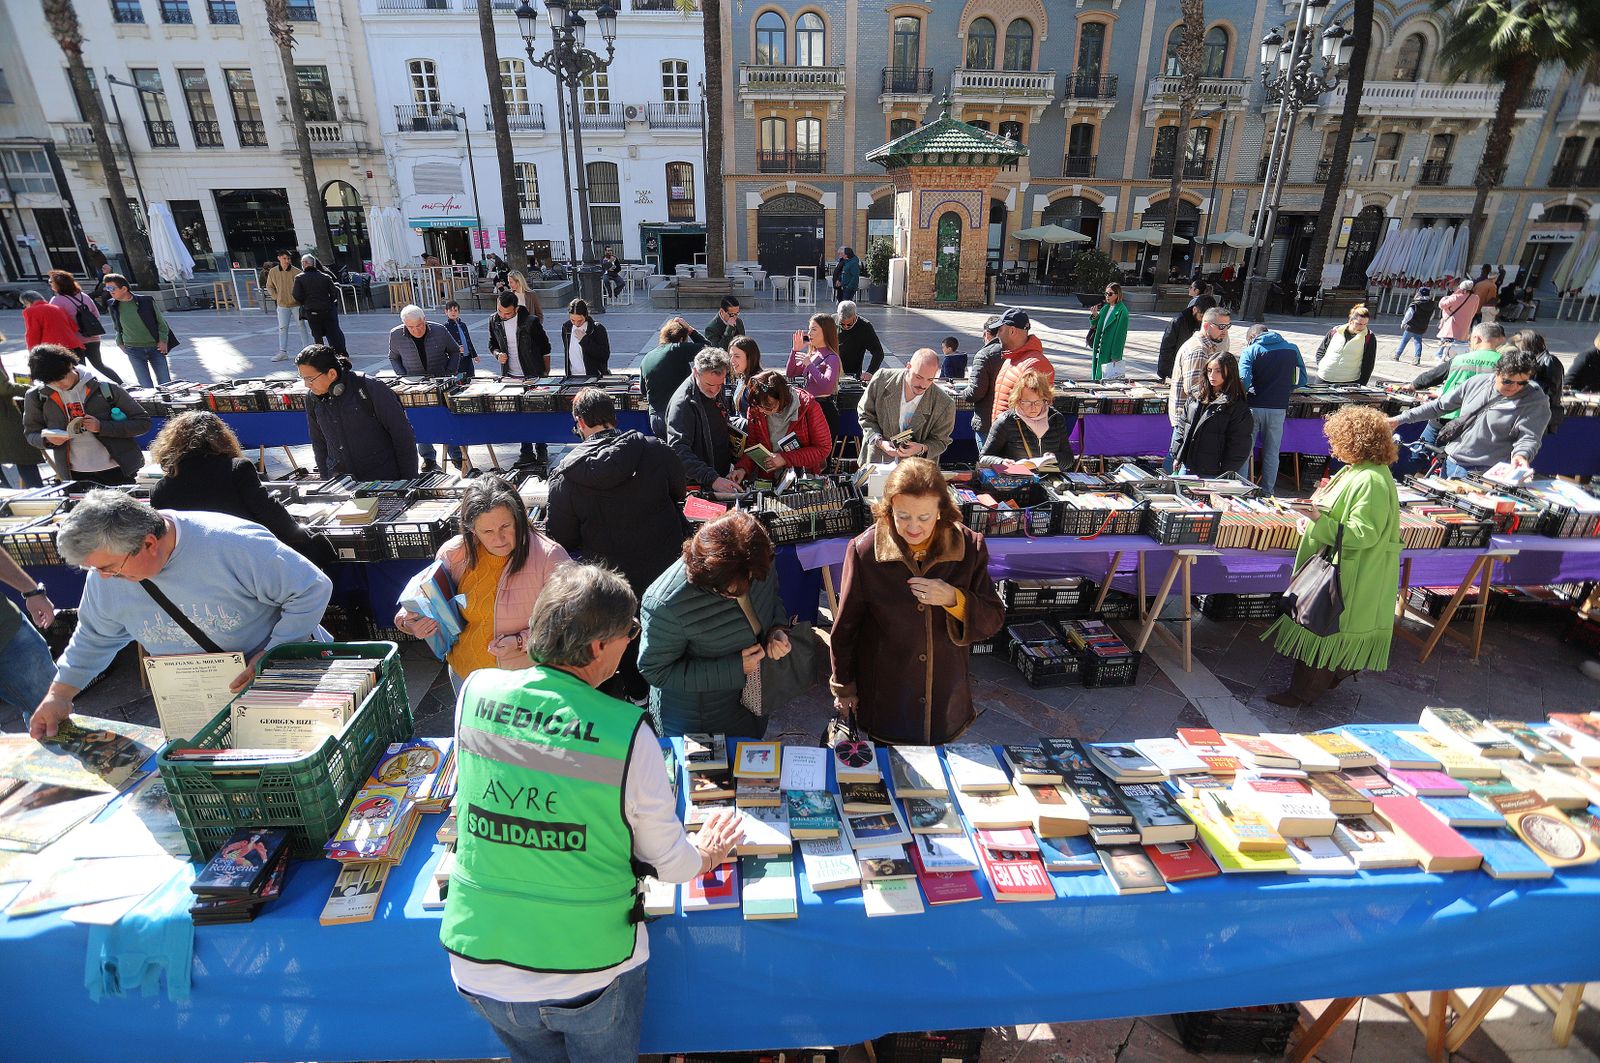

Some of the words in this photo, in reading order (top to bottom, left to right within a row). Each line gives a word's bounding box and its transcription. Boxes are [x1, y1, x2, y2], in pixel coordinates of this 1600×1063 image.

[475, 697, 600, 743] MEDICAL
[482, 779, 558, 814] AYRE
[1124, 789, 1154, 797] PRECIO
[468, 812, 585, 850] SOLIDARIO
[990, 865, 1014, 887] REY
[1007, 865, 1026, 887] MI
[1020, 864, 1048, 886] LUIS
